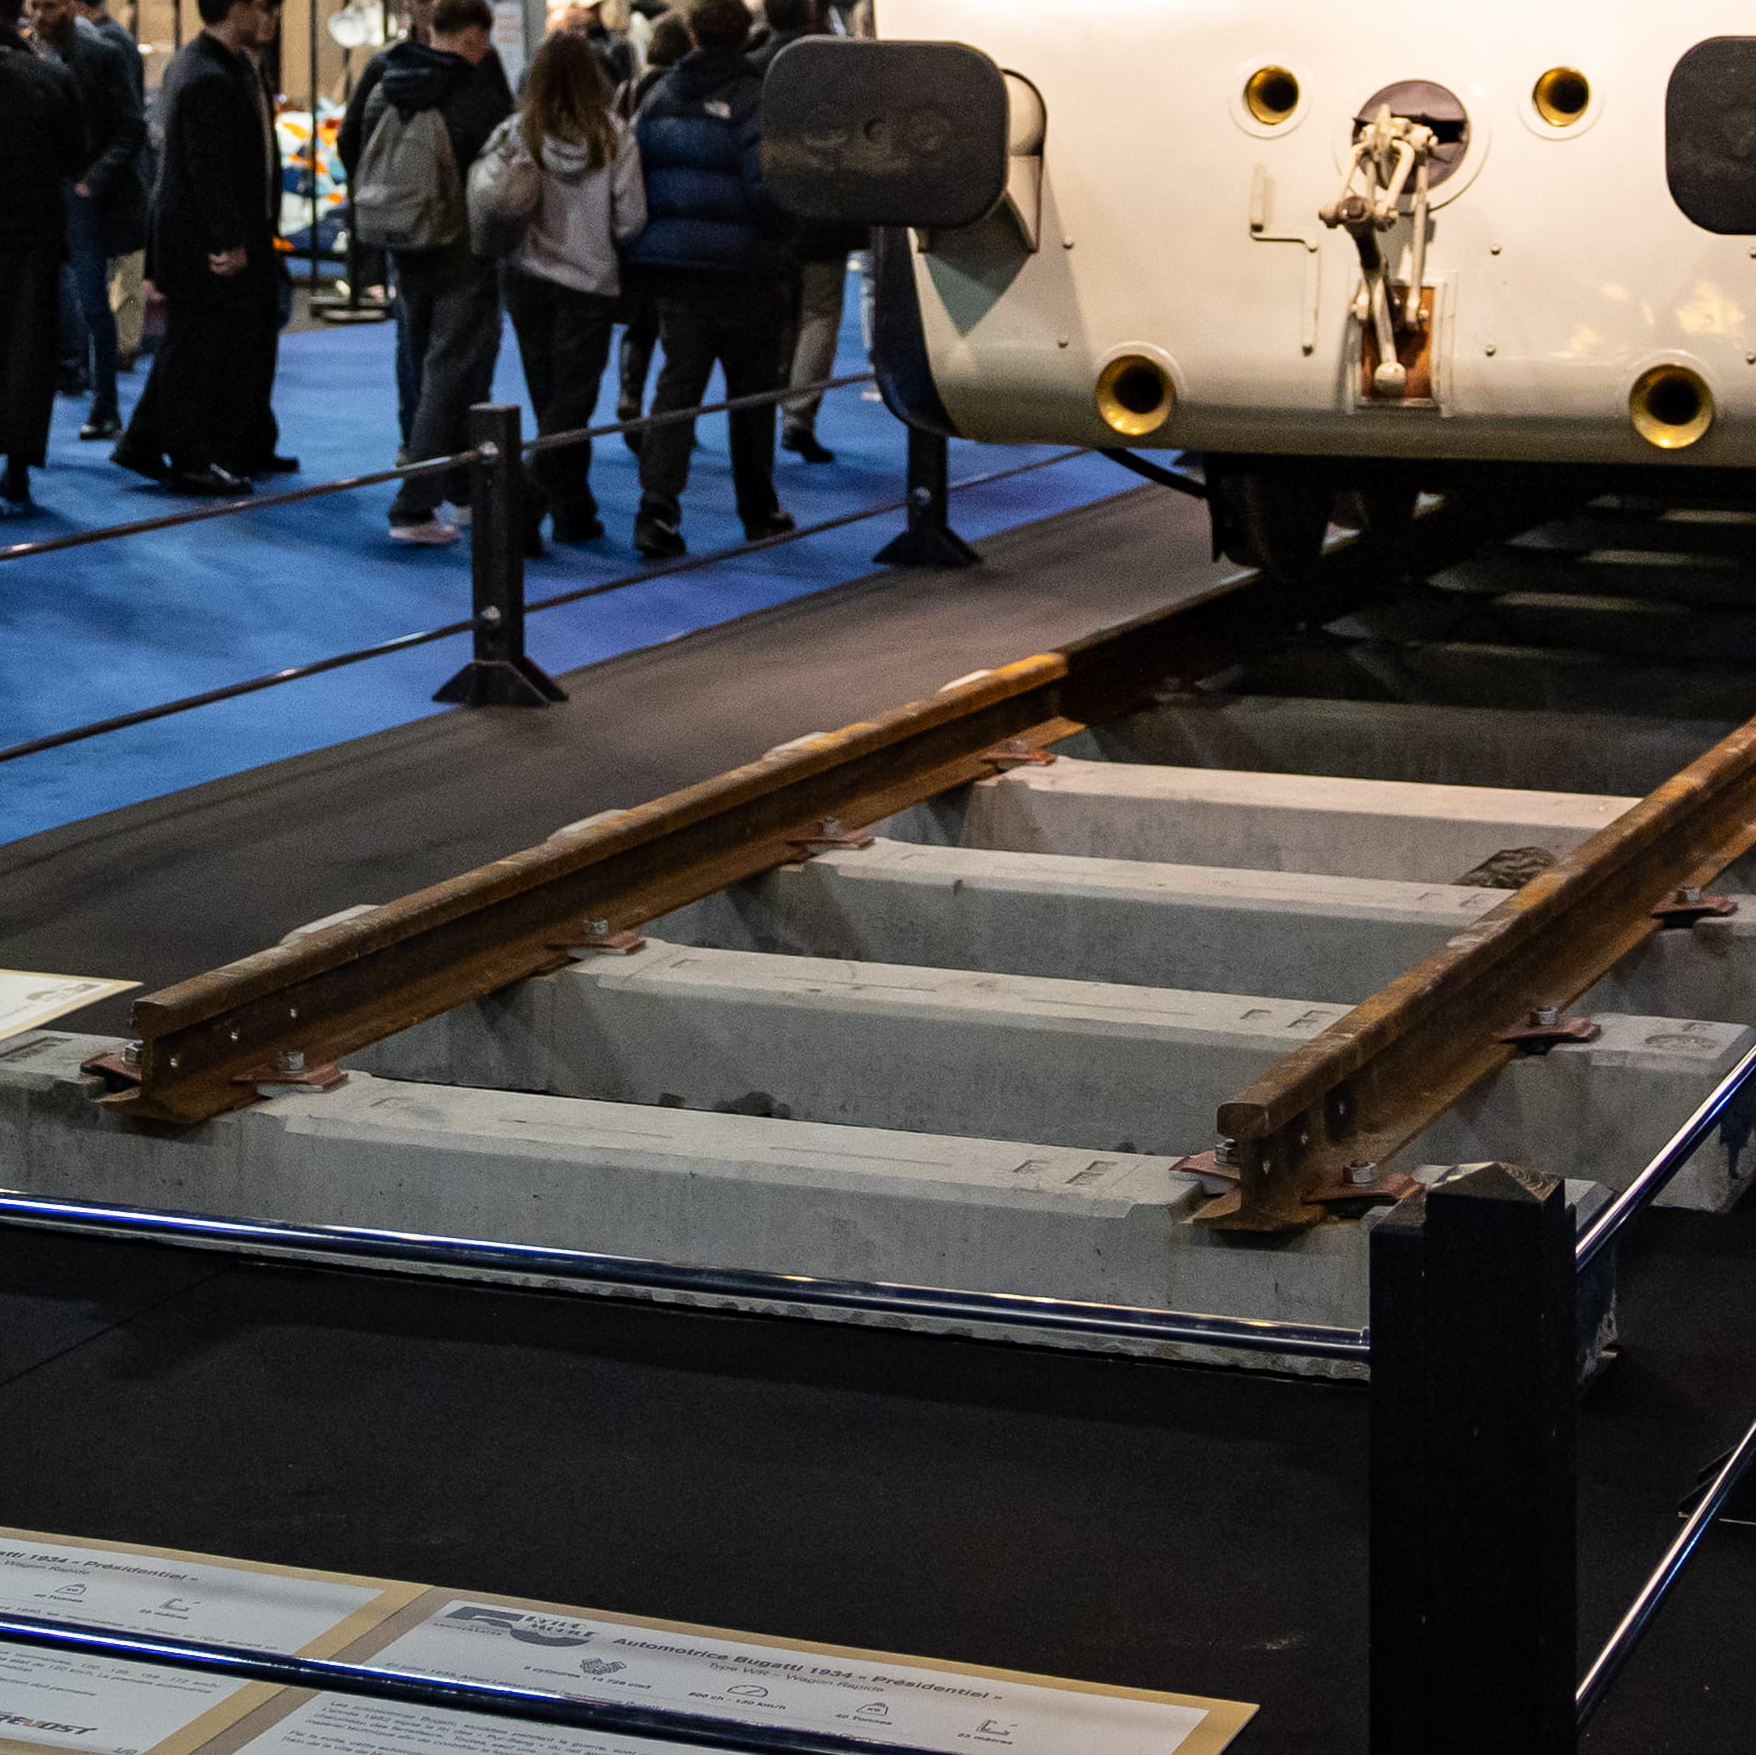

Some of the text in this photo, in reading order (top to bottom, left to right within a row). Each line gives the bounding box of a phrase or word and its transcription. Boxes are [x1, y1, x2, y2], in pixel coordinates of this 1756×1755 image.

[26, 1553, 71, 1564] 1934
[80, 1559, 190, 1581] Présidentiel
[608, 1637, 735, 1660] Automotrice
[727, 1655, 809, 1673] Bugatti
[804, 1666, 858, 1679] 1934
[867, 1675, 995, 1699] Présidentiel
